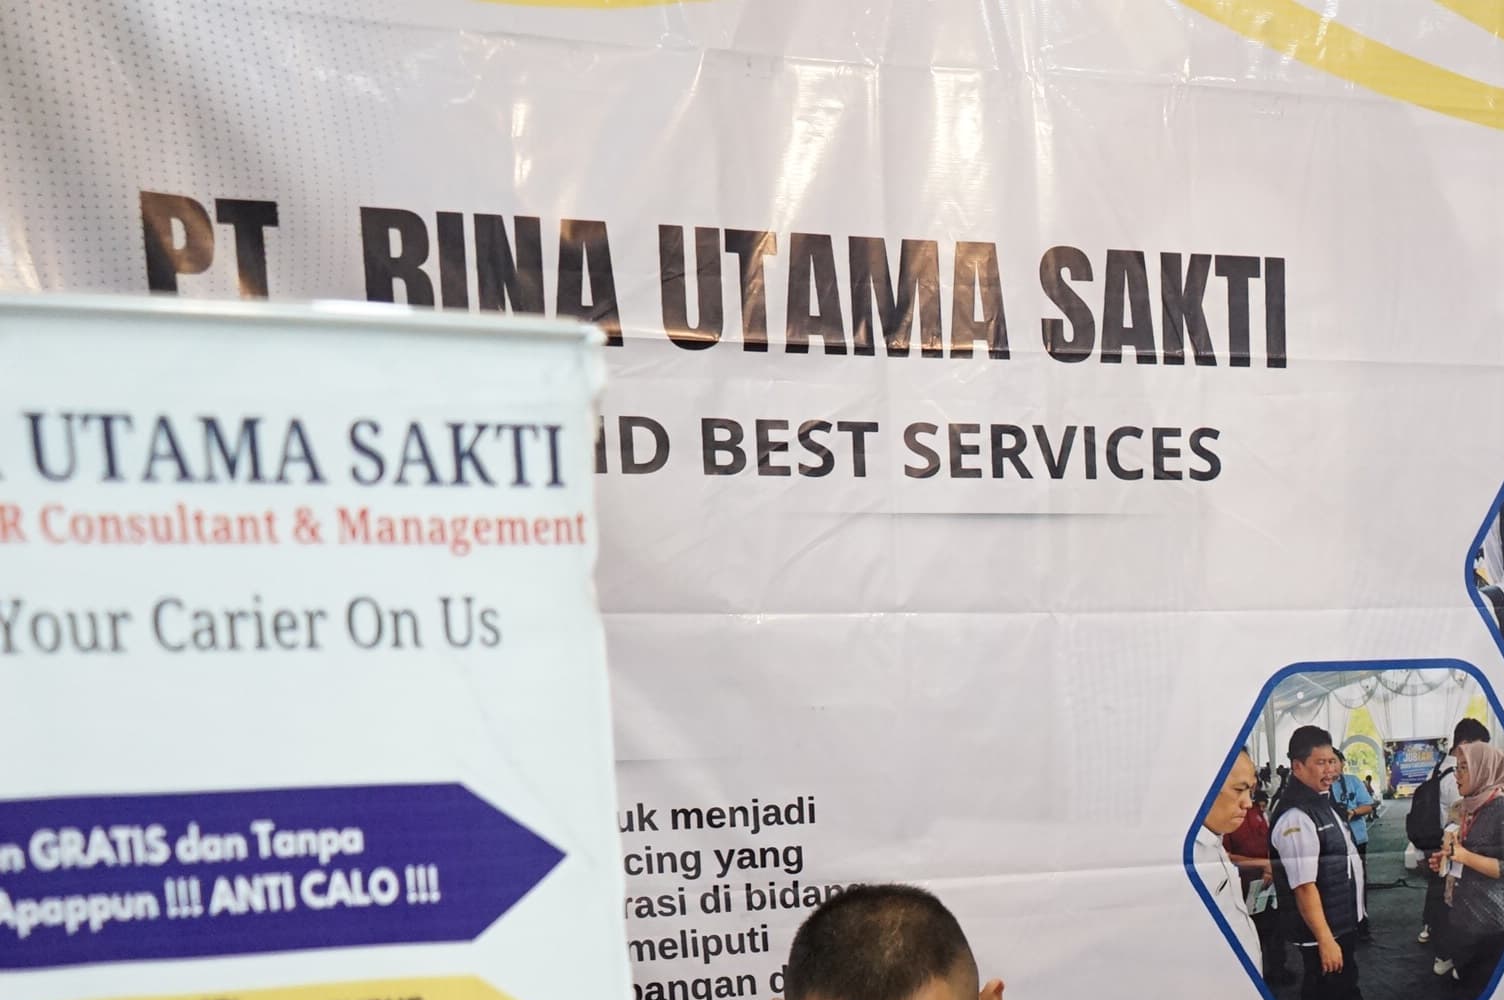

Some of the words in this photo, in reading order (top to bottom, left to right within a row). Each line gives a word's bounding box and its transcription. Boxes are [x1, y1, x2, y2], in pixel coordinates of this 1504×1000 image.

[359, 206, 623, 347] BINA
[659, 225, 1010, 360] UTAMA
[1039, 246, 1287, 368] SAKTI
[23, 412, 327, 485] UTAMA
[350, 419, 566, 488] SAKTI
[701, 417, 879, 478] BEST
[903, 423, 1222, 481] SERVICES
[40, 504, 279, 544] Consultant
[294, 507, 322, 543] &
[337, 507, 587, 555] Management
[153, 596, 327, 651] Carier
[348, 598, 420, 649] On
[440, 597, 501, 648] Us
[671, 796, 816, 834] menjadi
[29, 824, 170, 870] GRATIS
[175, 822, 246, 863] dan
[251, 819, 364, 865] Tanpa
[714, 845, 803, 878] yang
[210, 871, 295, 916] ANTI
[299, 869, 399, 909] CALO
[701, 884, 731, 913] di
